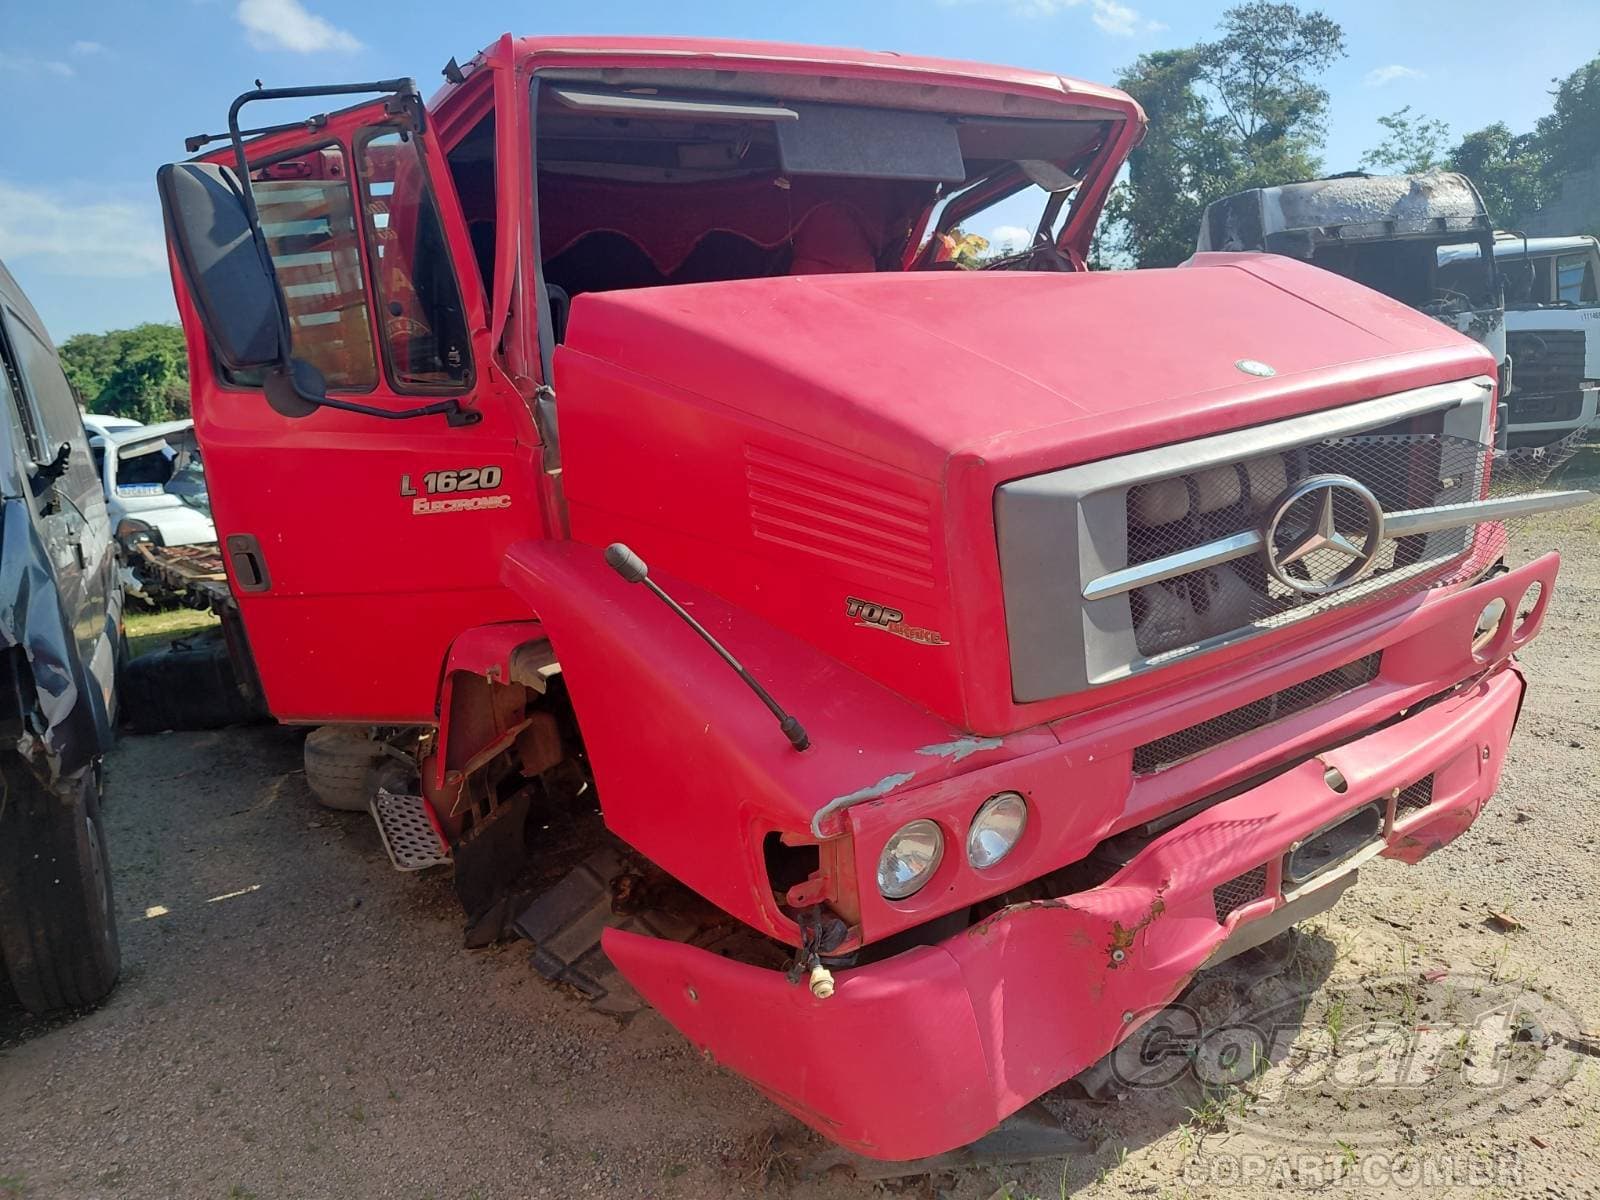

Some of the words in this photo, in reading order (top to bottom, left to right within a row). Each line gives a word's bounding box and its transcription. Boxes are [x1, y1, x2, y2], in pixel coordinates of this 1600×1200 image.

[400, 474, 417, 496] L
[423, 465, 502, 494] 1620
[845, 596, 904, 626] TOP
